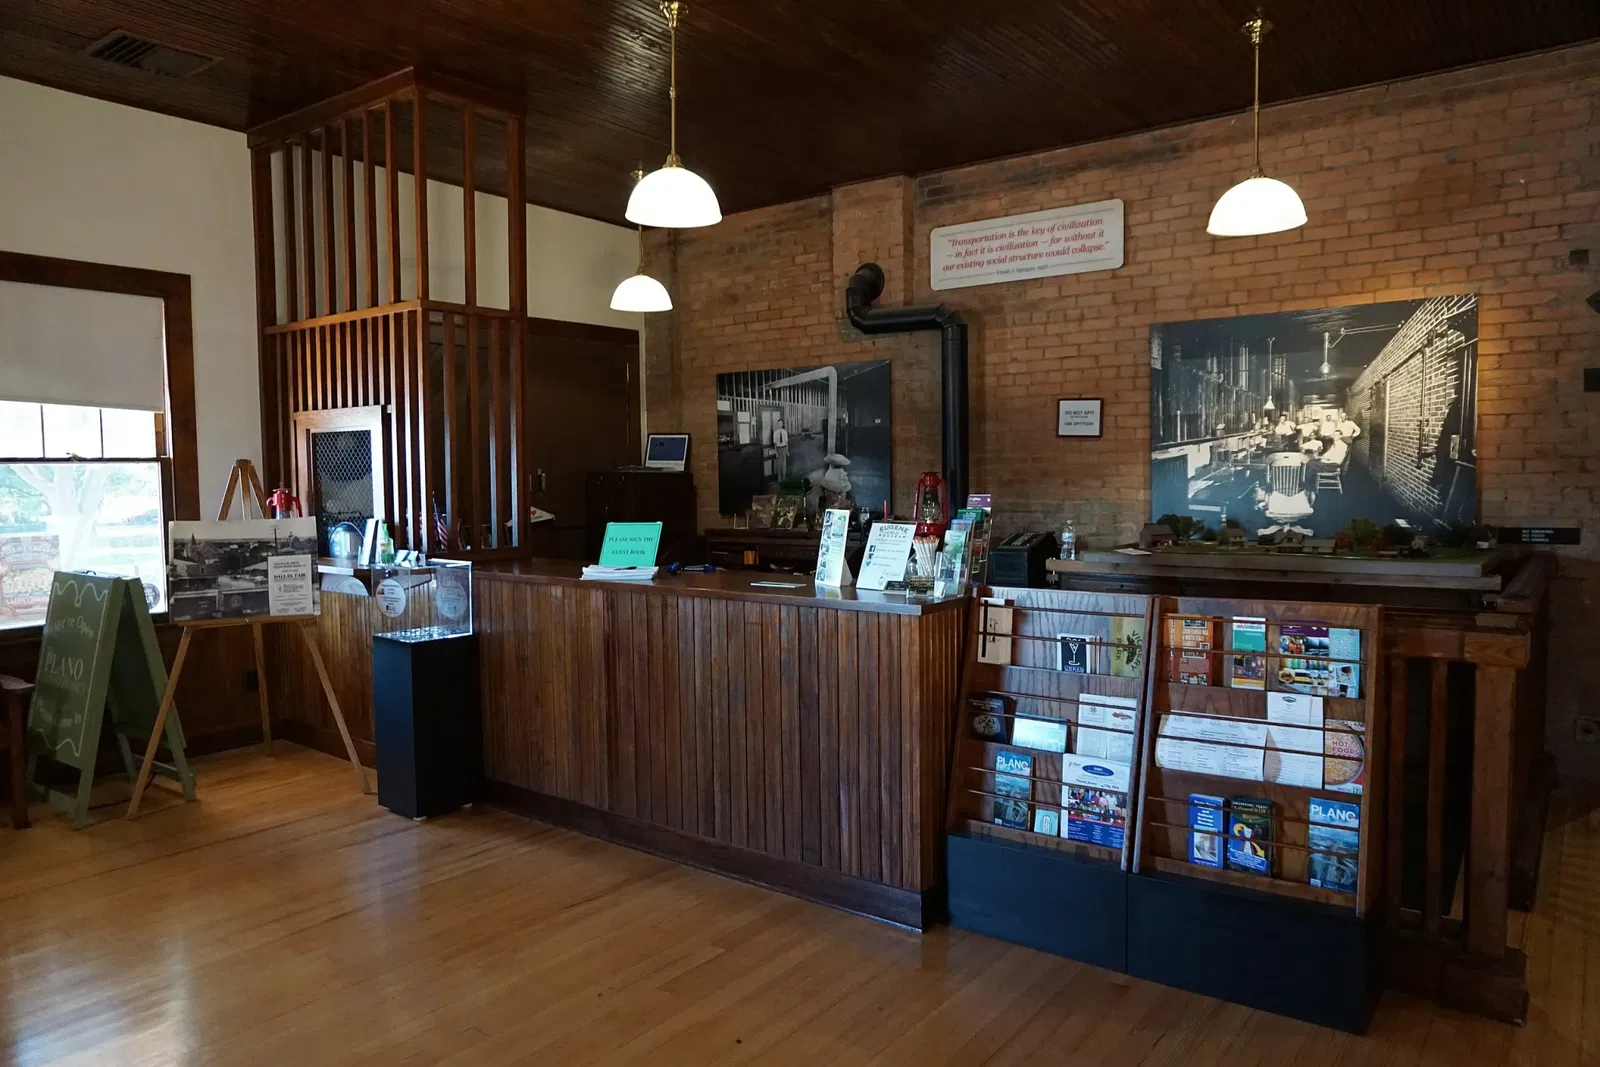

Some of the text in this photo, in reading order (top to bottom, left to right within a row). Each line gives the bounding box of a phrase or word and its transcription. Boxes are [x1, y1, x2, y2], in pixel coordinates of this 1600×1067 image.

[1008, 230, 1015, 238] is
[1017, 228, 1030, 237] the
[1031, 227, 1046, 236] key
[1047, 224, 1056, 234] of
[1057, 218, 1103, 230] civilization
[955, 249, 962, 258] in
[963, 248, 978, 259] fact
[996, 240, 1038, 252] civilization
[1048, 236, 1062, 247] for
[1064, 232, 1096, 243] without
[1098, 228, 1104, 238] it
[956, 260, 984, 270] existing
[986, 255, 1008, 265] social
[1008, 251, 1044, 262] structure
[1045, 246, 1070, 257] would
[880, 525, 909, 534] EUGENE
[44, 651, 84, 681] PLANO
[1332, 747, 1360, 755] FOODS
[997, 756, 1028, 770] PLANO
[1311, 804, 1356, 821] PLANO
